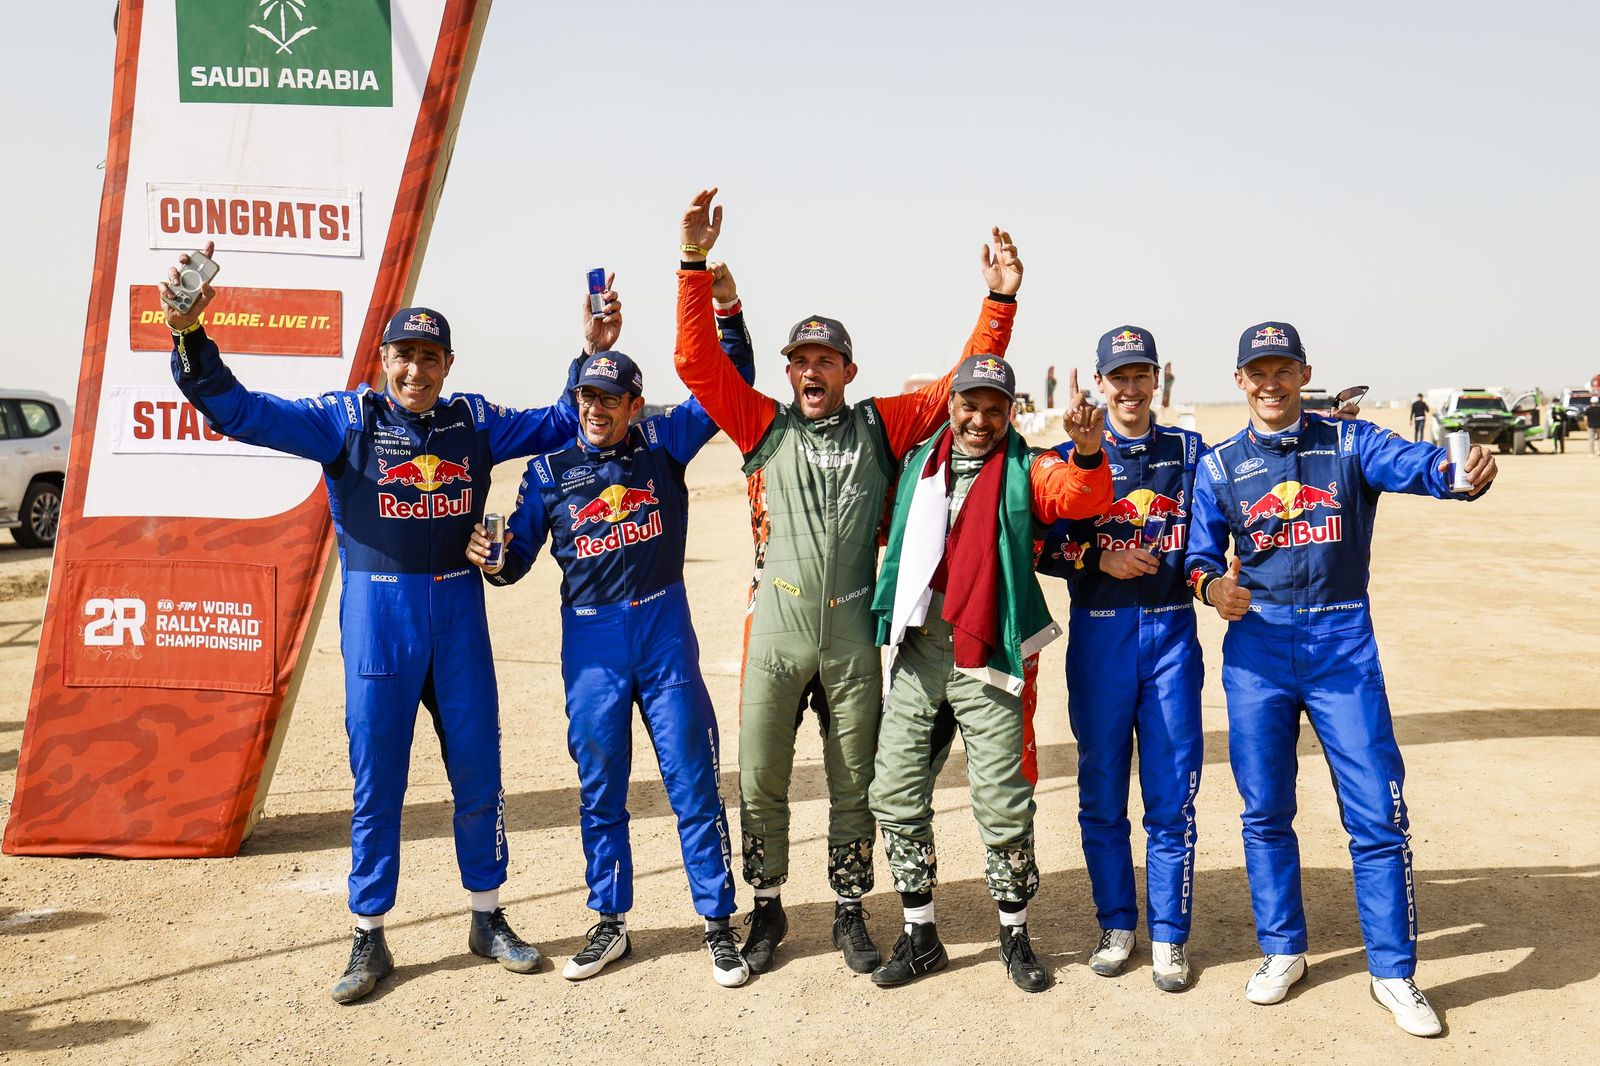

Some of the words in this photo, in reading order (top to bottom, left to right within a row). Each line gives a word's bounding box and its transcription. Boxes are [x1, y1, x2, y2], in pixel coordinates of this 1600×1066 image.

[191, 66, 270, 88] SAUDI
[277, 68, 380, 91] ARABIA
[160, 197, 350, 242] CONGRATS!
[212, 312, 265, 328] DARE.
[268, 314, 308, 329] LIVE
[310, 315, 332, 330] IT.
[403, 321, 422, 332] Red
[422, 322, 440, 336] Bull
[796, 330, 815, 341] Red
[814, 330, 830, 340] Bull
[1251, 336, 1270, 349] Red
[1270, 336, 1289, 347] Bull
[1112, 343, 1128, 354] Red
[1128, 342, 1145, 351] Bull
[585, 367, 600, 376] Red
[600, 367, 619, 380] Bull
[972, 369, 989, 378] Red
[990, 370, 1005, 383] Bull
[384, 448, 411, 456] VISION
[565, 466, 590, 479] Ford
[378, 492, 430, 519] Red
[431, 488, 473, 518] Bull
[575, 525, 622, 560] Red
[621, 509, 663, 547] Bull
[1096, 529, 1142, 551] Red
[1159, 524, 1187, 552] ull
[1249, 522, 1291, 553] Red
[1292, 515, 1342, 547] Bull
[443, 569, 470, 580] ROMA
[639, 589, 666, 605] HARO
[157, 600, 174, 611] FIA
[202, 600, 253, 617] WORLD
[1090, 609, 1116, 617] sparco
[156, 614, 260, 637] RALLY-RAID
[156, 633, 263, 652] CHAMPIONSHIP
[1404, 868, 1416, 942] FORD
